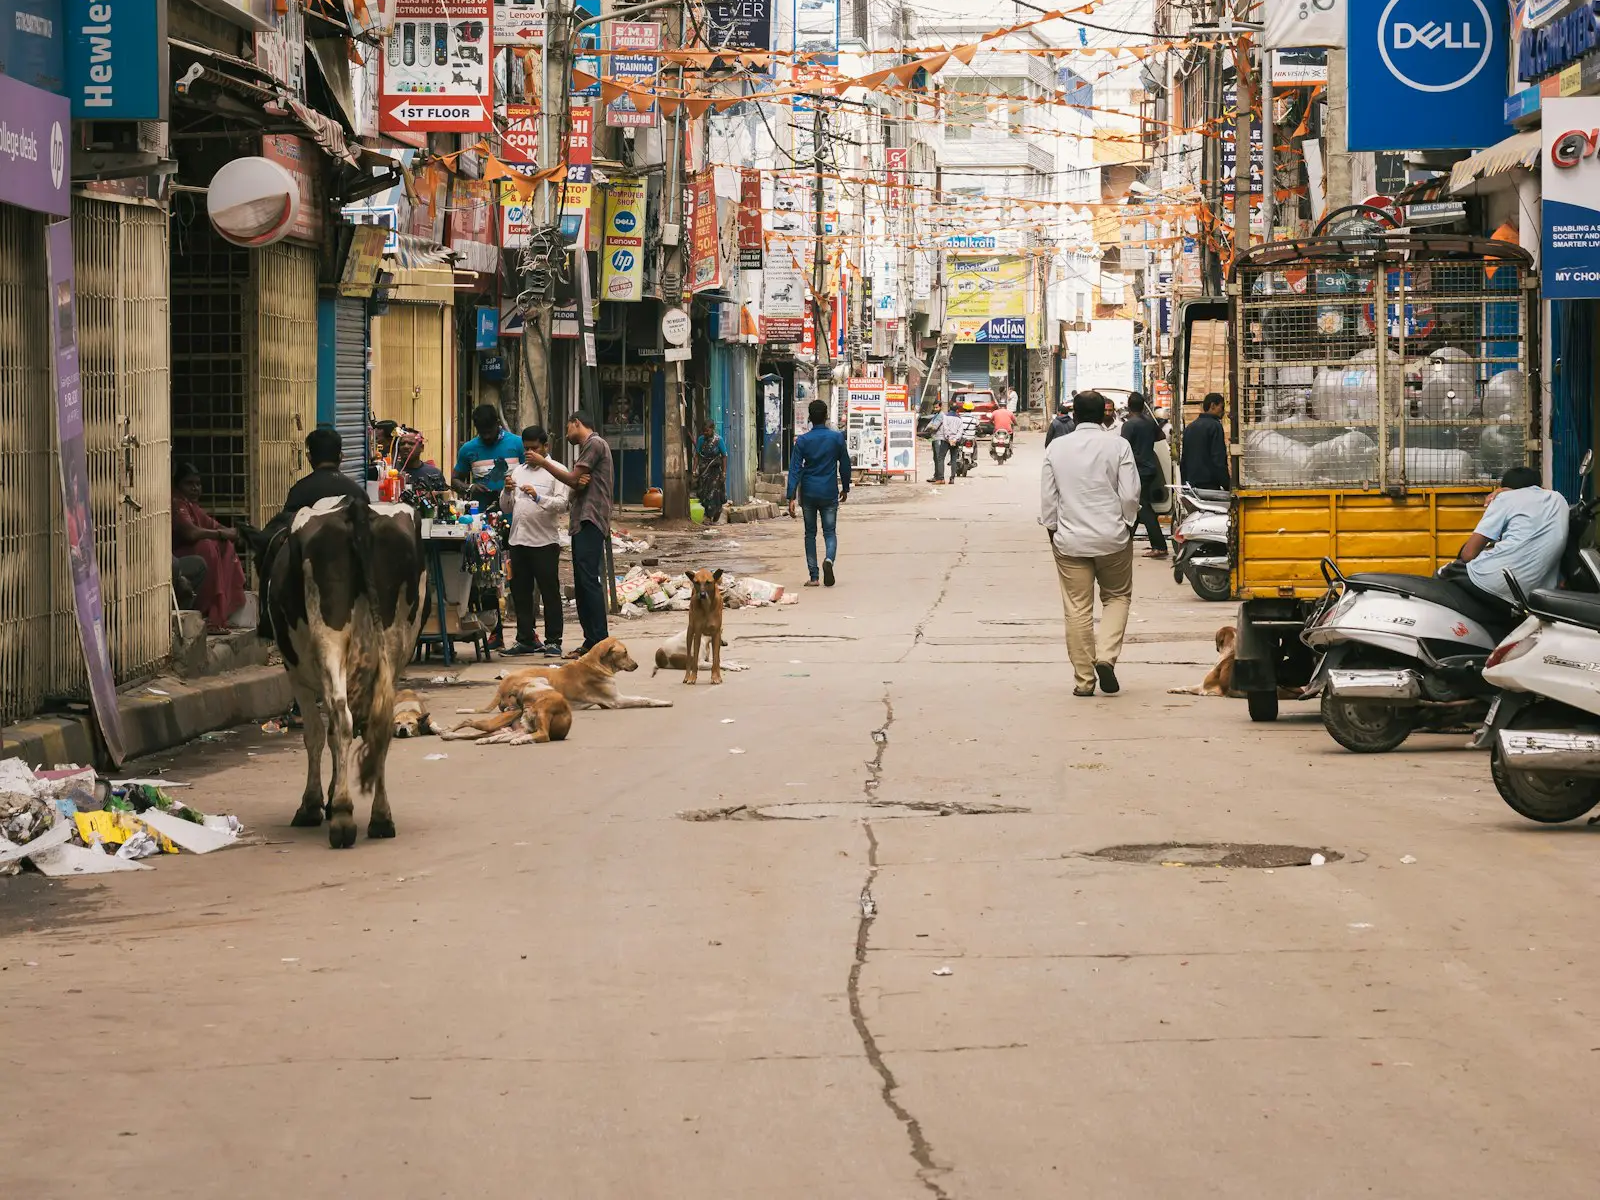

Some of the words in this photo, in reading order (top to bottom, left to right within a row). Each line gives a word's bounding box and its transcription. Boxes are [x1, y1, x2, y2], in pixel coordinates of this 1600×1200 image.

[396, 6, 433, 14] ECTRONIC
[434, 6, 488, 15] COMPONENTS
[509, 11, 541, 19] Lenovo
[615, 27, 656, 37] S.M.D.
[1393, 20, 1481, 50] DELL
[615, 38, 656, 47] MOBILES
[614, 62, 654, 71] TRAINING
[1274, 70, 1310, 78] HIKVISION
[400, 108, 424, 118] 1ST
[427, 107, 470, 118] FLOOR
[629, 114, 651, 124] FLOOR
[19, 128, 38, 163] deals
[608, 190, 644, 199] COMPUTER
[1432, 201, 1463, 211] COMPUTER
[508, 208, 522, 221] hp
[615, 218, 635, 226] DELL
[1552, 232, 1585, 240] SOCIETY
[1585, 232, 1599, 240] AND
[609, 237, 638, 245] Lenovo
[1552, 240, 1588, 248] SMARTER
[613, 249, 634, 272] hp
[1555, 271, 1572, 281] MY
[1573, 271, 1600, 282] CHOI
